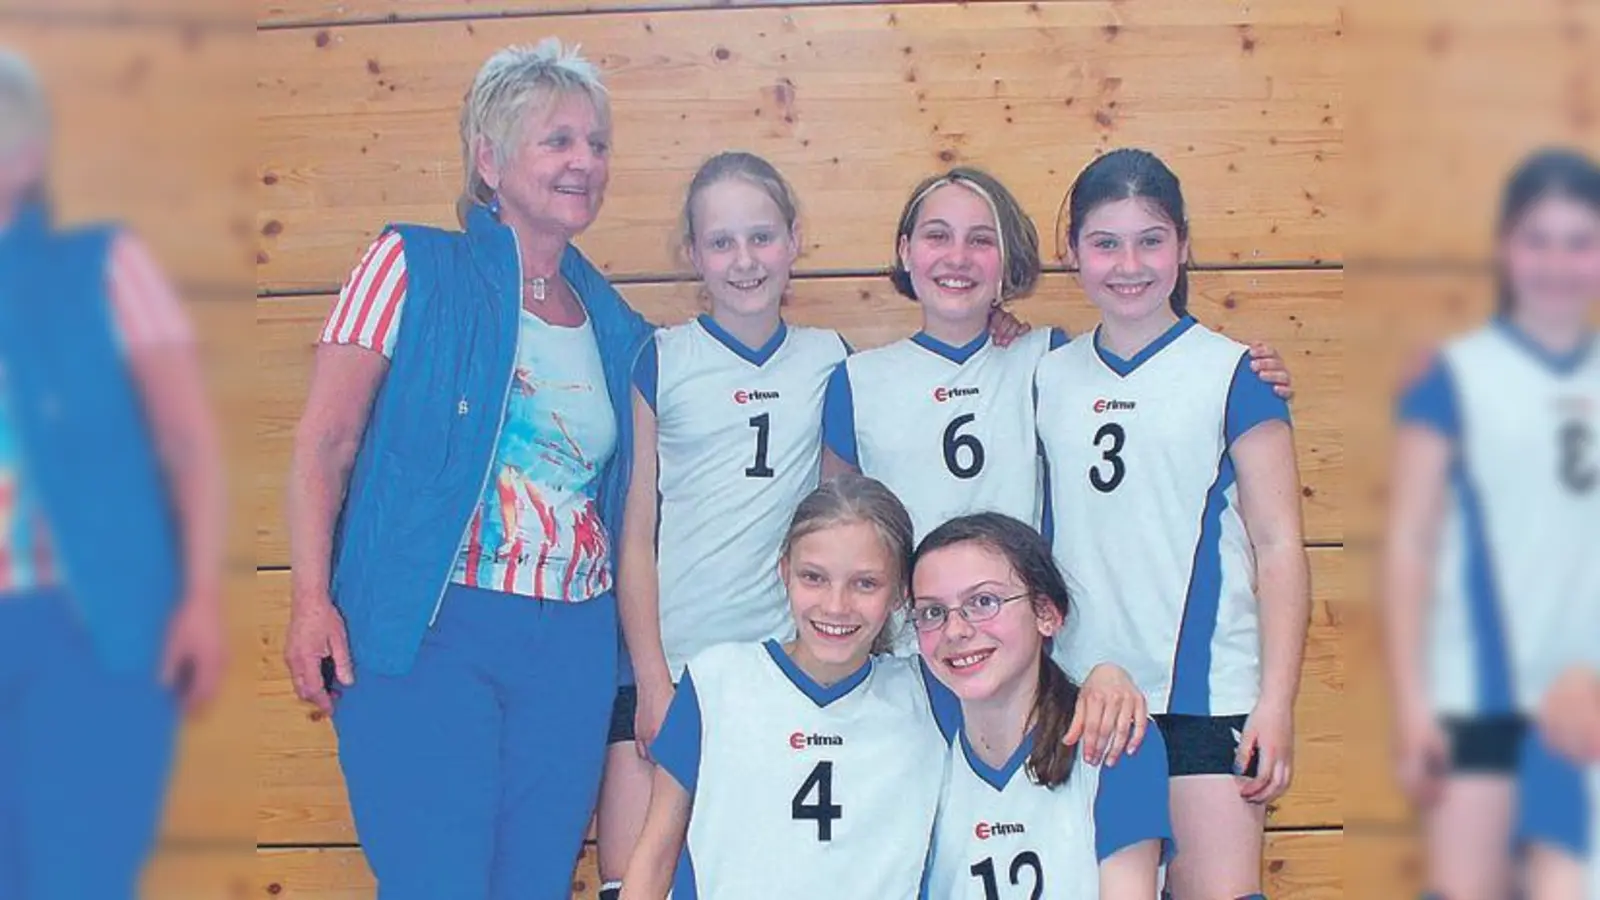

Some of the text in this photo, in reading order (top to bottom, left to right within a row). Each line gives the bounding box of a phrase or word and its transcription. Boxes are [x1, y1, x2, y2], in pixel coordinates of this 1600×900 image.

[745, 412, 774, 478] 1
[943, 413, 985, 479] 6
[1089, 422, 1125, 493] 3
[792, 760, 842, 841] 4
[970, 850, 1044, 900] 12
